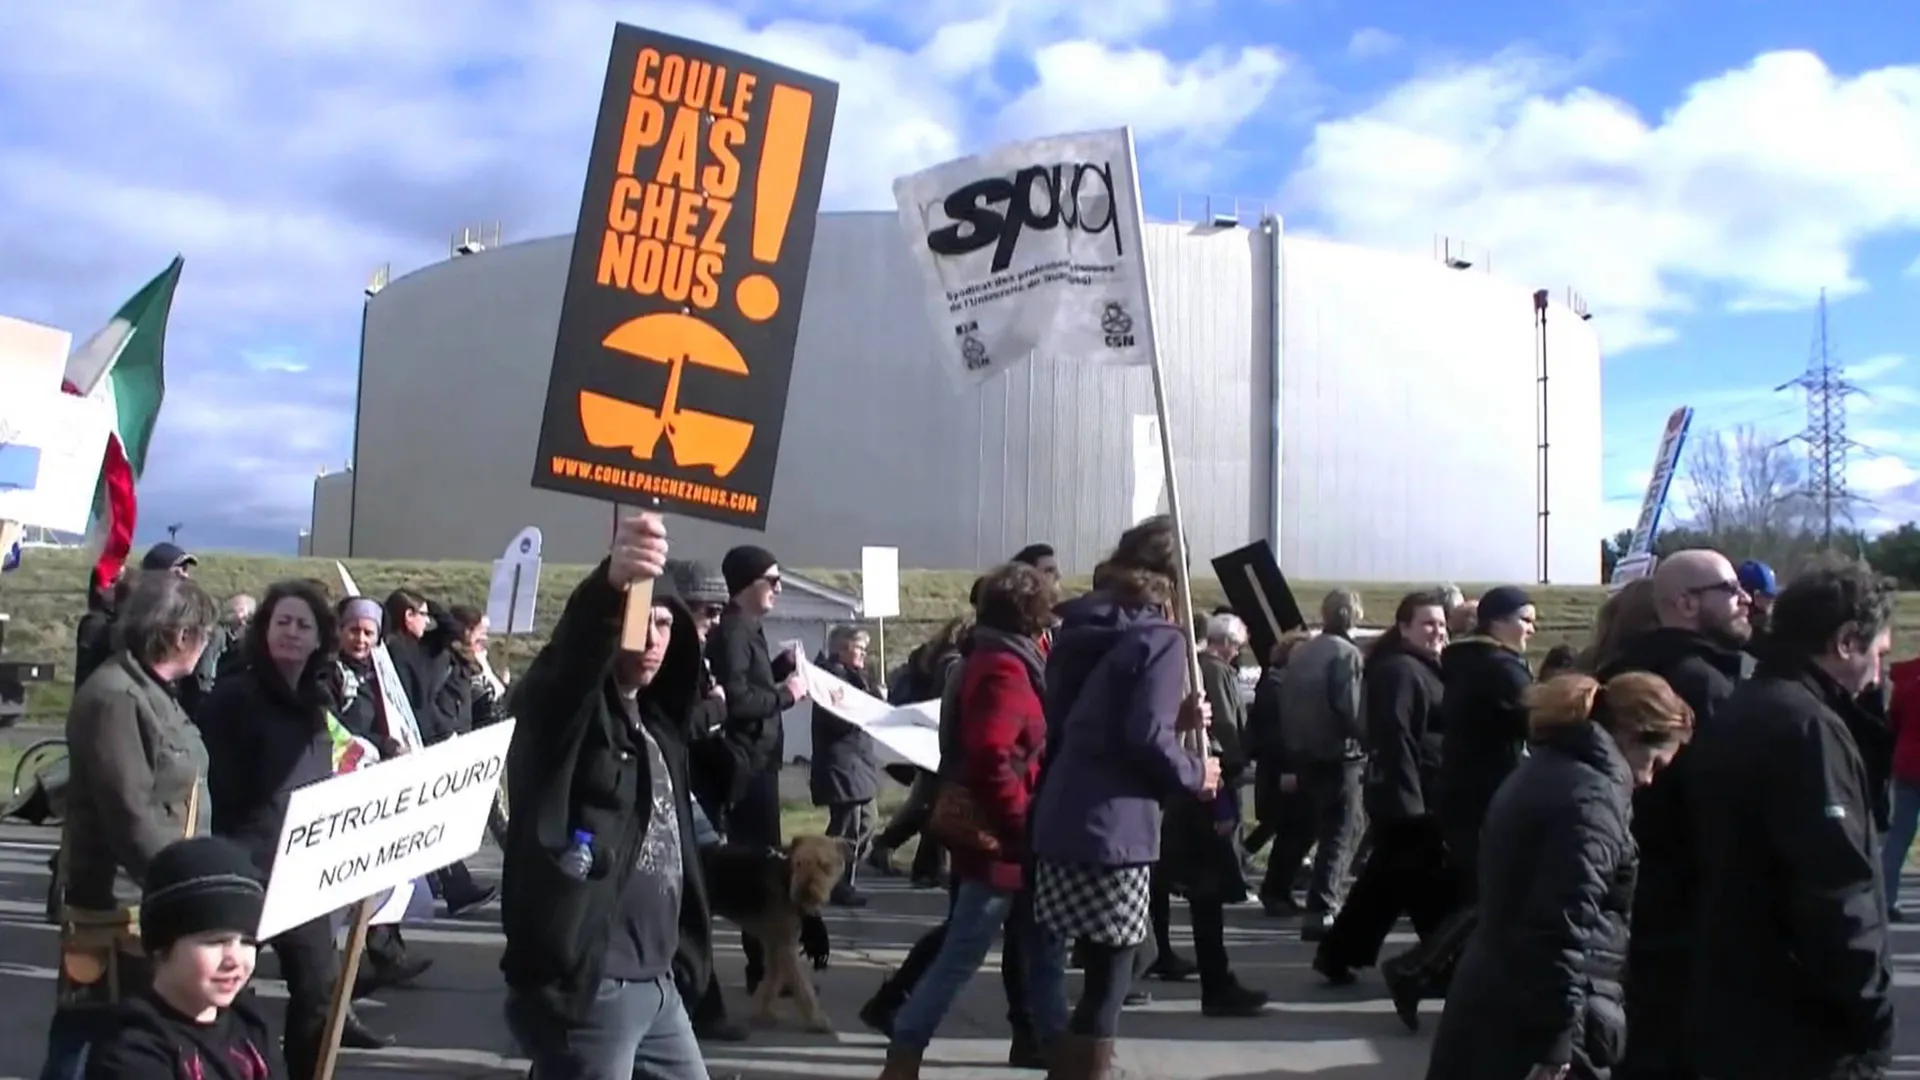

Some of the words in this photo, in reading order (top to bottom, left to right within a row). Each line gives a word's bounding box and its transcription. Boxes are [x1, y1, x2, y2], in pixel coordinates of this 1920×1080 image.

[632, 47, 757, 122] COULE
[616, 93, 747, 200] PAS
[607, 176, 734, 256] CHEZ
[596, 229, 725, 309] NOUS
[552, 455, 759, 513] WWW.COULEPASCHEZNOUS.COM
[285, 785, 413, 857] PÉTROLE
[417, 755, 501, 806] LOURD
[318, 854, 371, 891] NON
[374, 822, 446, 868] MERCI
